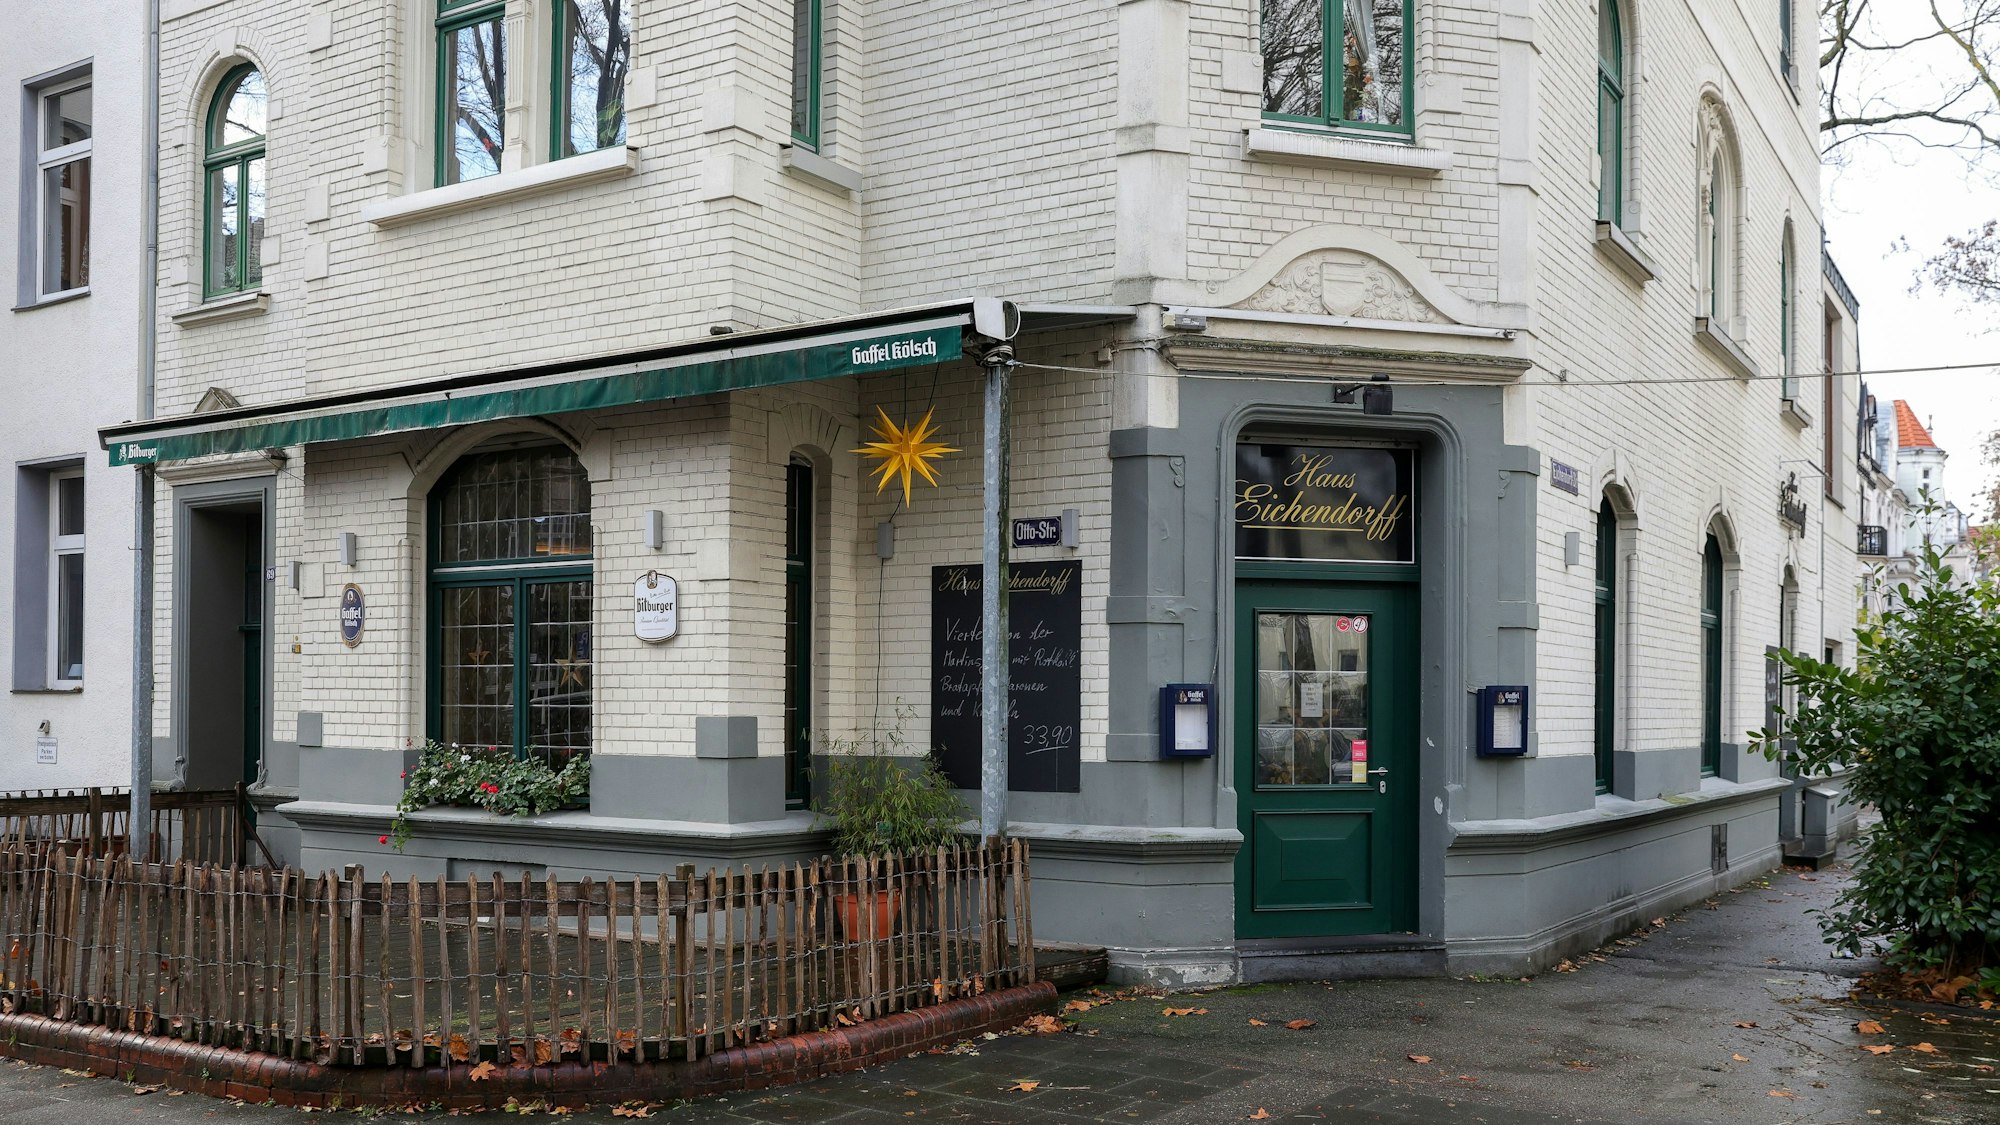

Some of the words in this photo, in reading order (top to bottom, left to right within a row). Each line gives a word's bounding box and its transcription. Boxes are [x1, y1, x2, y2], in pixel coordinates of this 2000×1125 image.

[852, 343, 890, 364] Gaffel
[892, 336, 936, 360] Kölsch
[127, 443, 157, 459] Bitburger
[1283, 453, 1356, 489] Haus
[1234, 480, 1407, 541] Eichendorff
[1016, 521, 1056, 540] Otto-Str.
[938, 568, 982, 592] Haus
[342, 606, 362, 620] Gaffel
[636, 597, 674, 614] Bitburger
[946, 616, 984, 641] Vierte
[1029, 620, 1054, 640] der
[941, 699, 965, 717] und
[1023, 725, 1073, 747] 33,90
